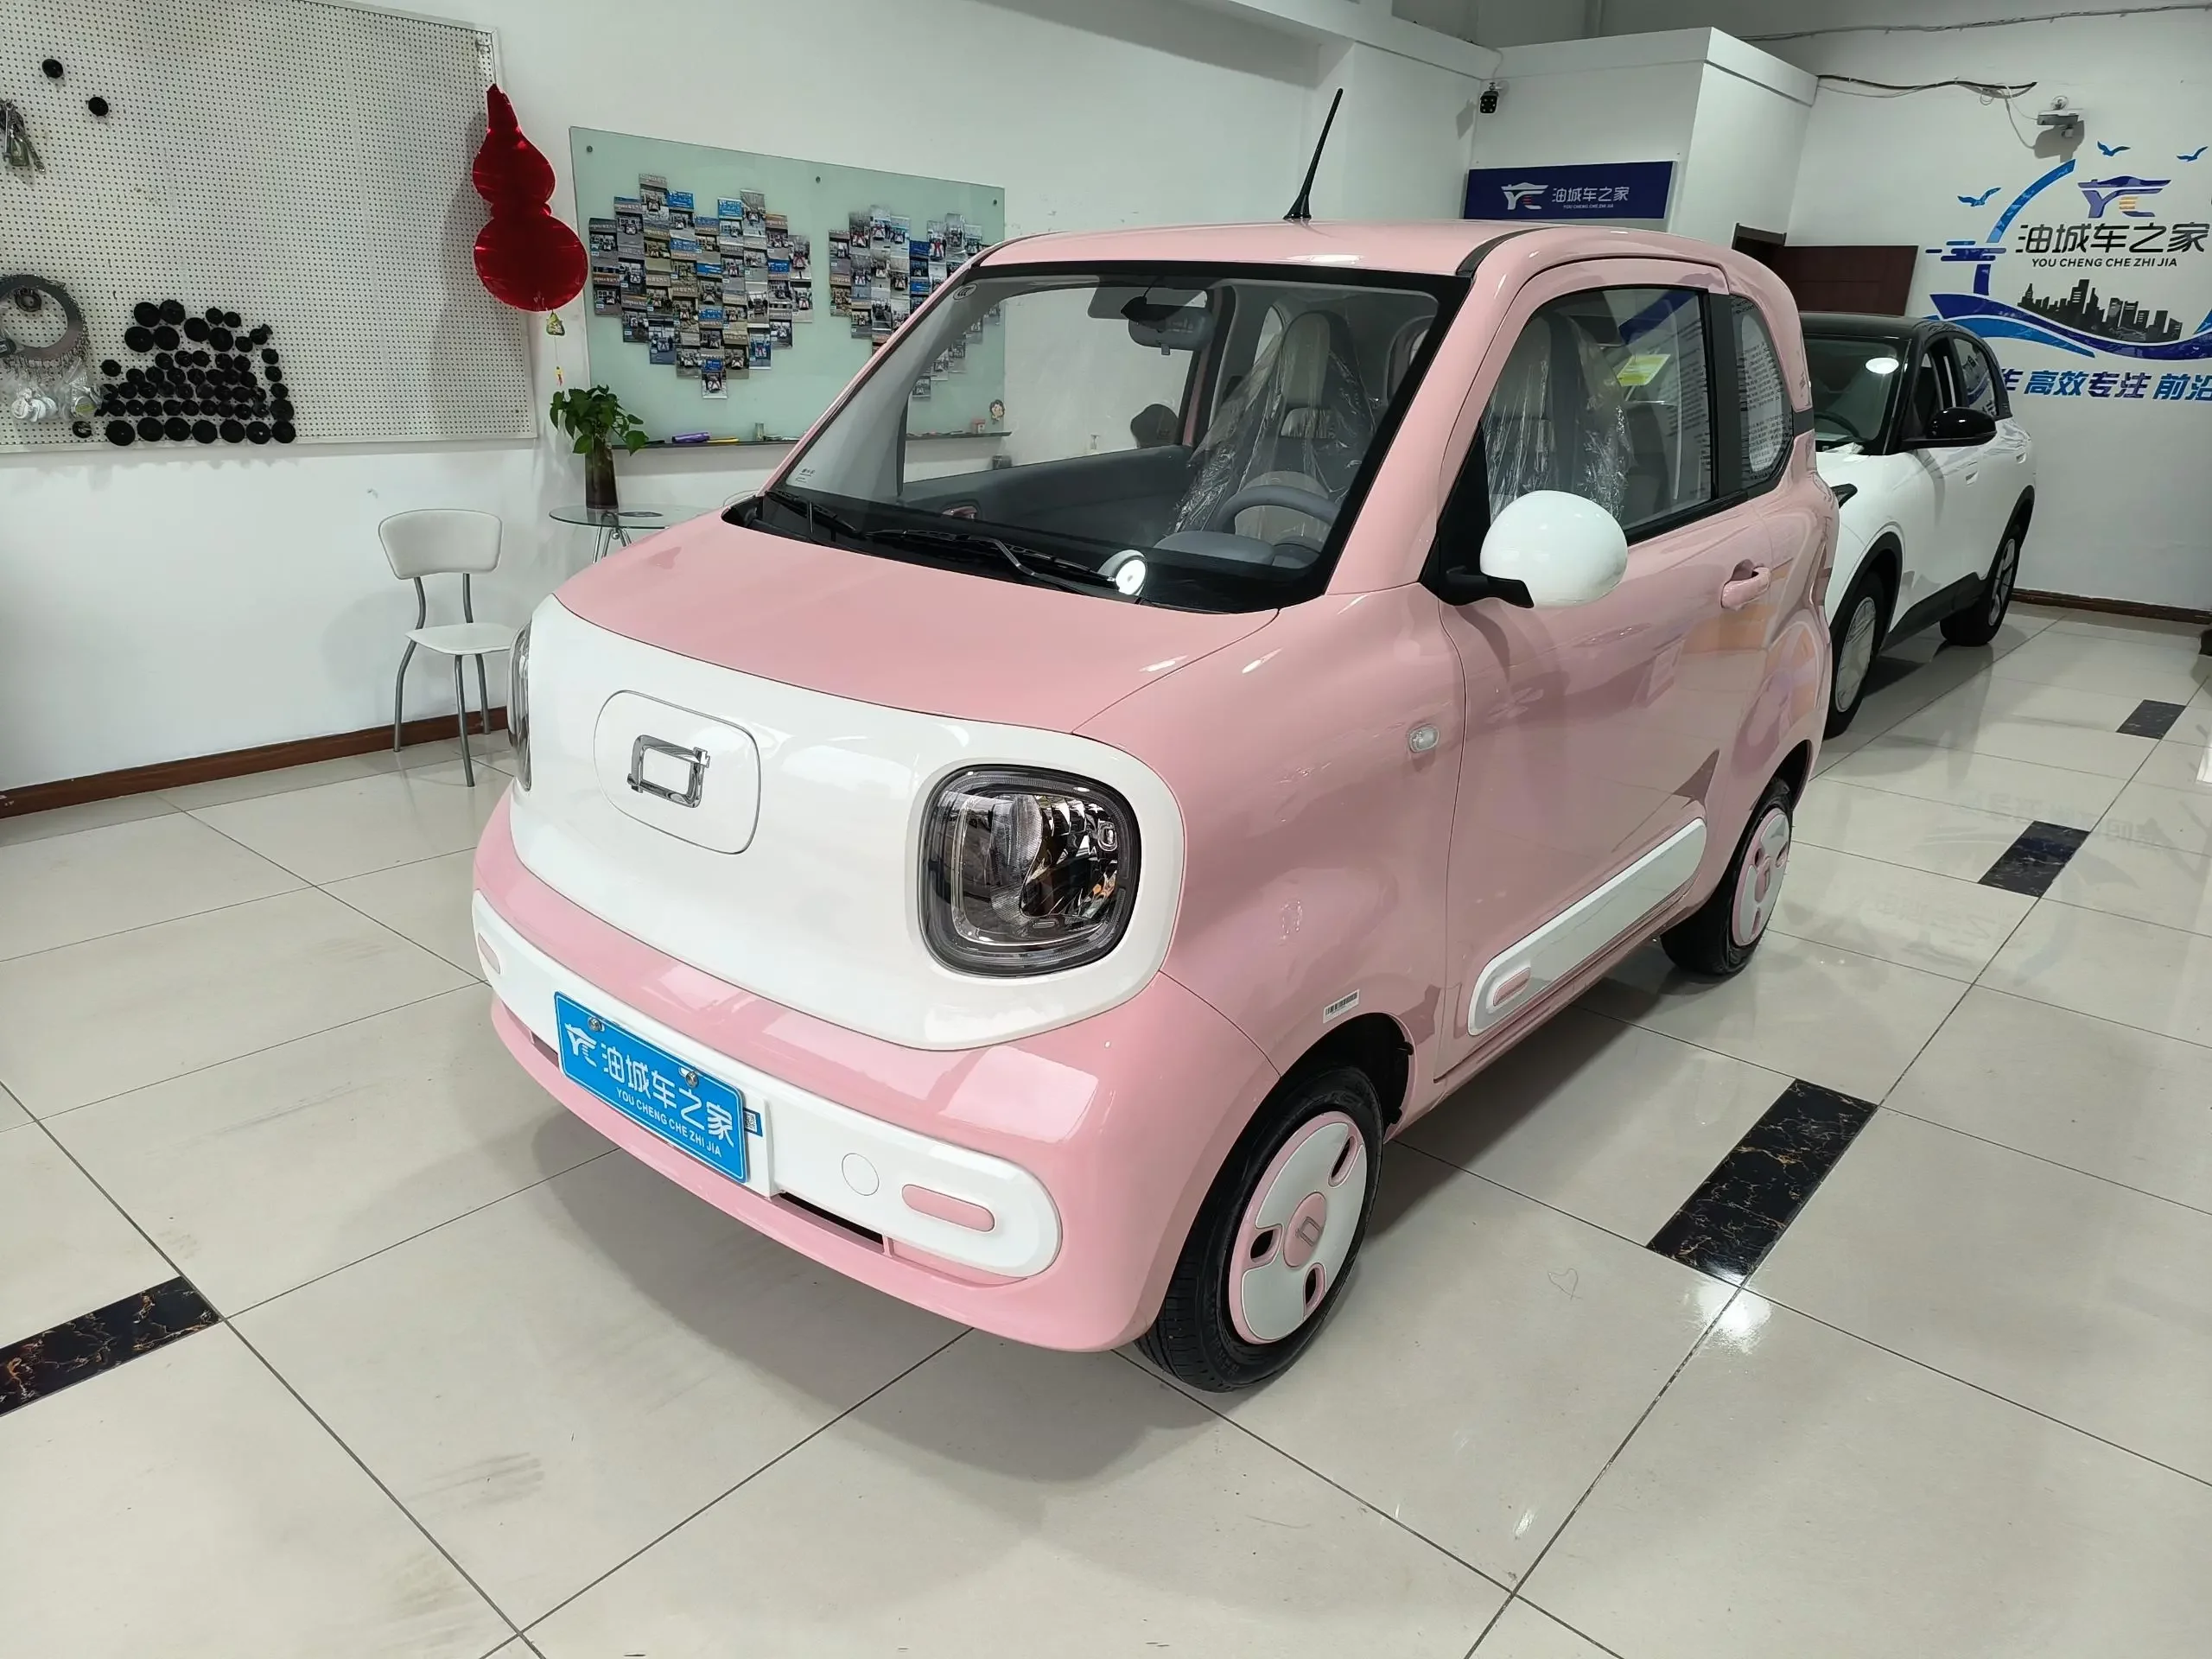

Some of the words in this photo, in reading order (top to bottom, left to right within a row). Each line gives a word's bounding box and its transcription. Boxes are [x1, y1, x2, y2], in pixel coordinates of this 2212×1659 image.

[1552, 187, 1630, 202] 油城车之家
[2016, 222, 2210, 253] 油城车之家
[2032, 258, 2056, 268] YOU
[2060, 257, 2102, 267] CHENG
[2106, 257, 2132, 267] CHE
[2133, 257, 2155, 267] ZHI
[2158, 257, 2177, 267] JIA
[2024, 370, 2152, 398] 高效专注
[2152, 373, 2212, 401] 前沿
[601, 1042, 734, 1148] 油城车之家
[616, 1087, 635, 1108] YOU
[636, 1099, 668, 1125] CHENG
[669, 1118, 688, 1140] CHE
[689, 1129, 704, 1148] ZHI
[706, 1141, 722, 1158] JIA
